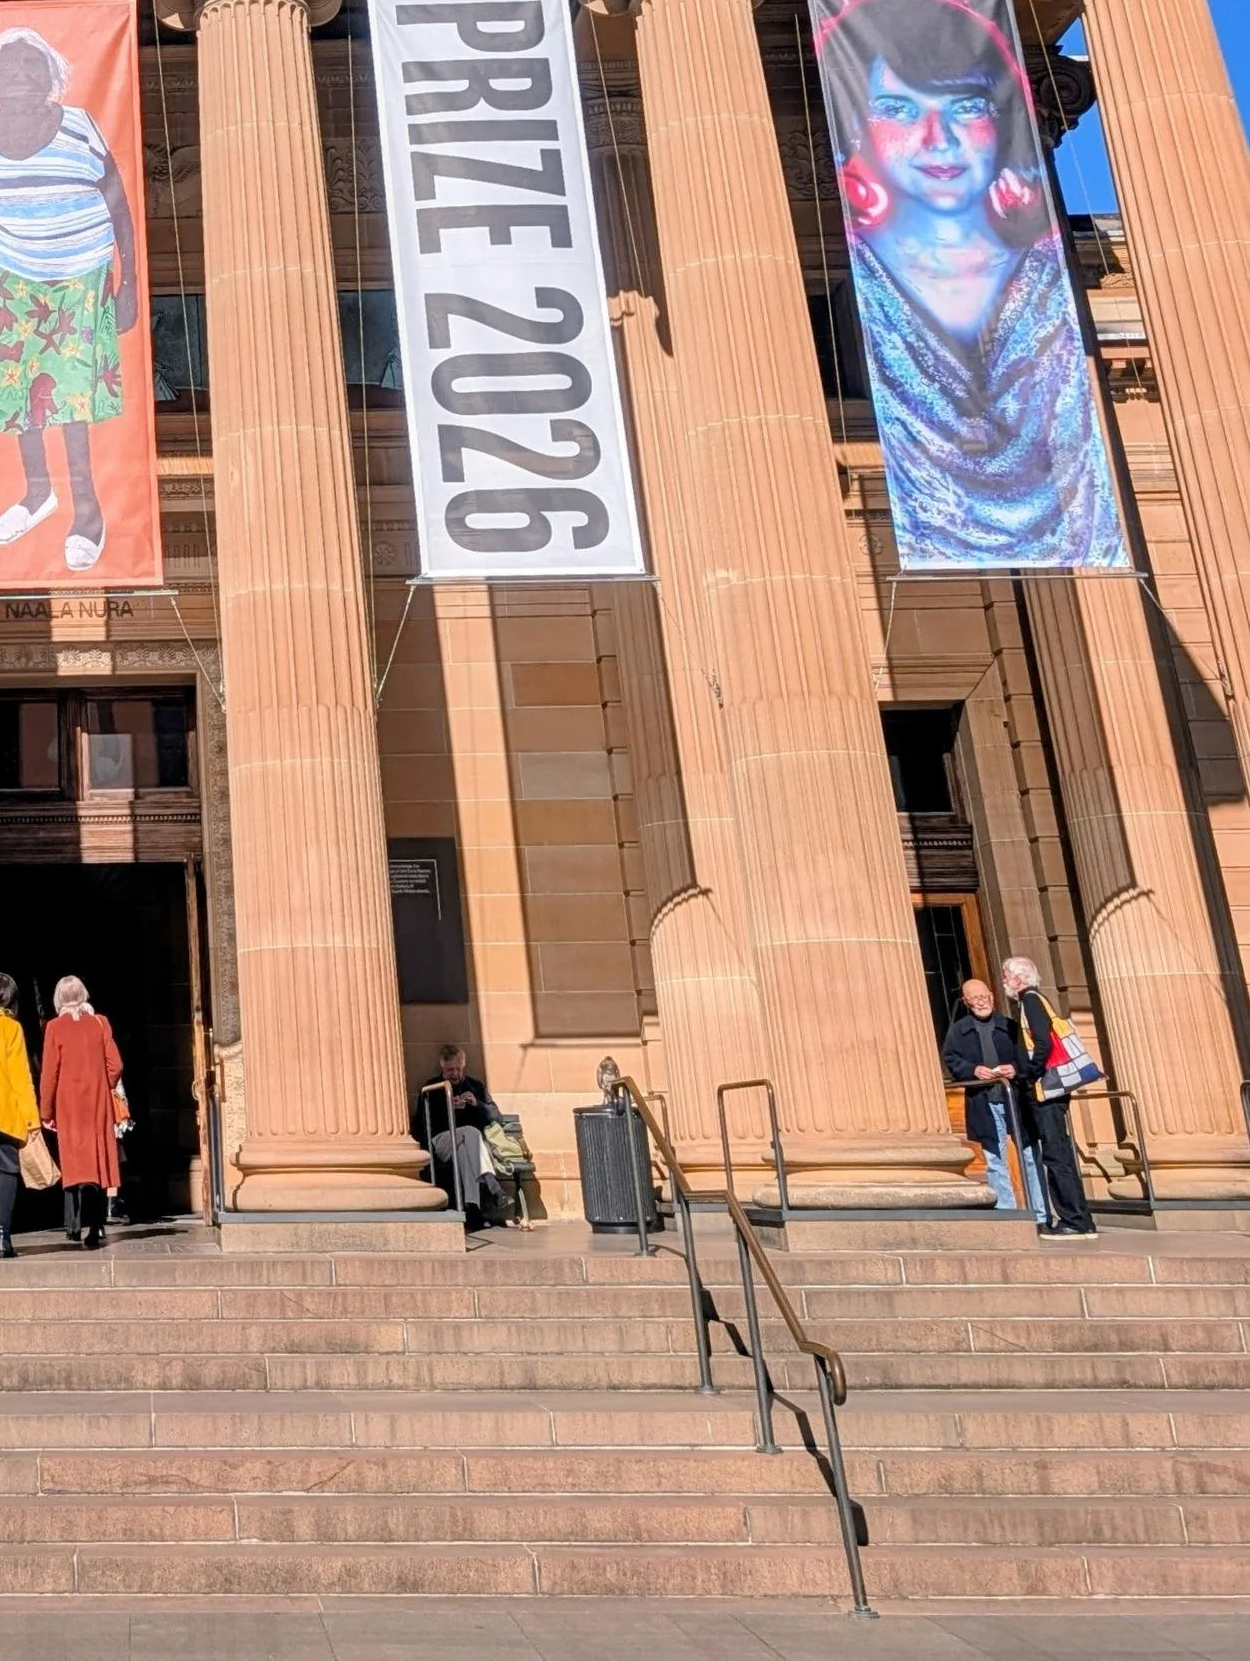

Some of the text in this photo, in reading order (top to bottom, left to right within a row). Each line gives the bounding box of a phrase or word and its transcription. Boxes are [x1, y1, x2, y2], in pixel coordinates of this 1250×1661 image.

[395, 0, 610, 553] PRIZE 2026
[5, 600, 134, 619] NAALA NURA
